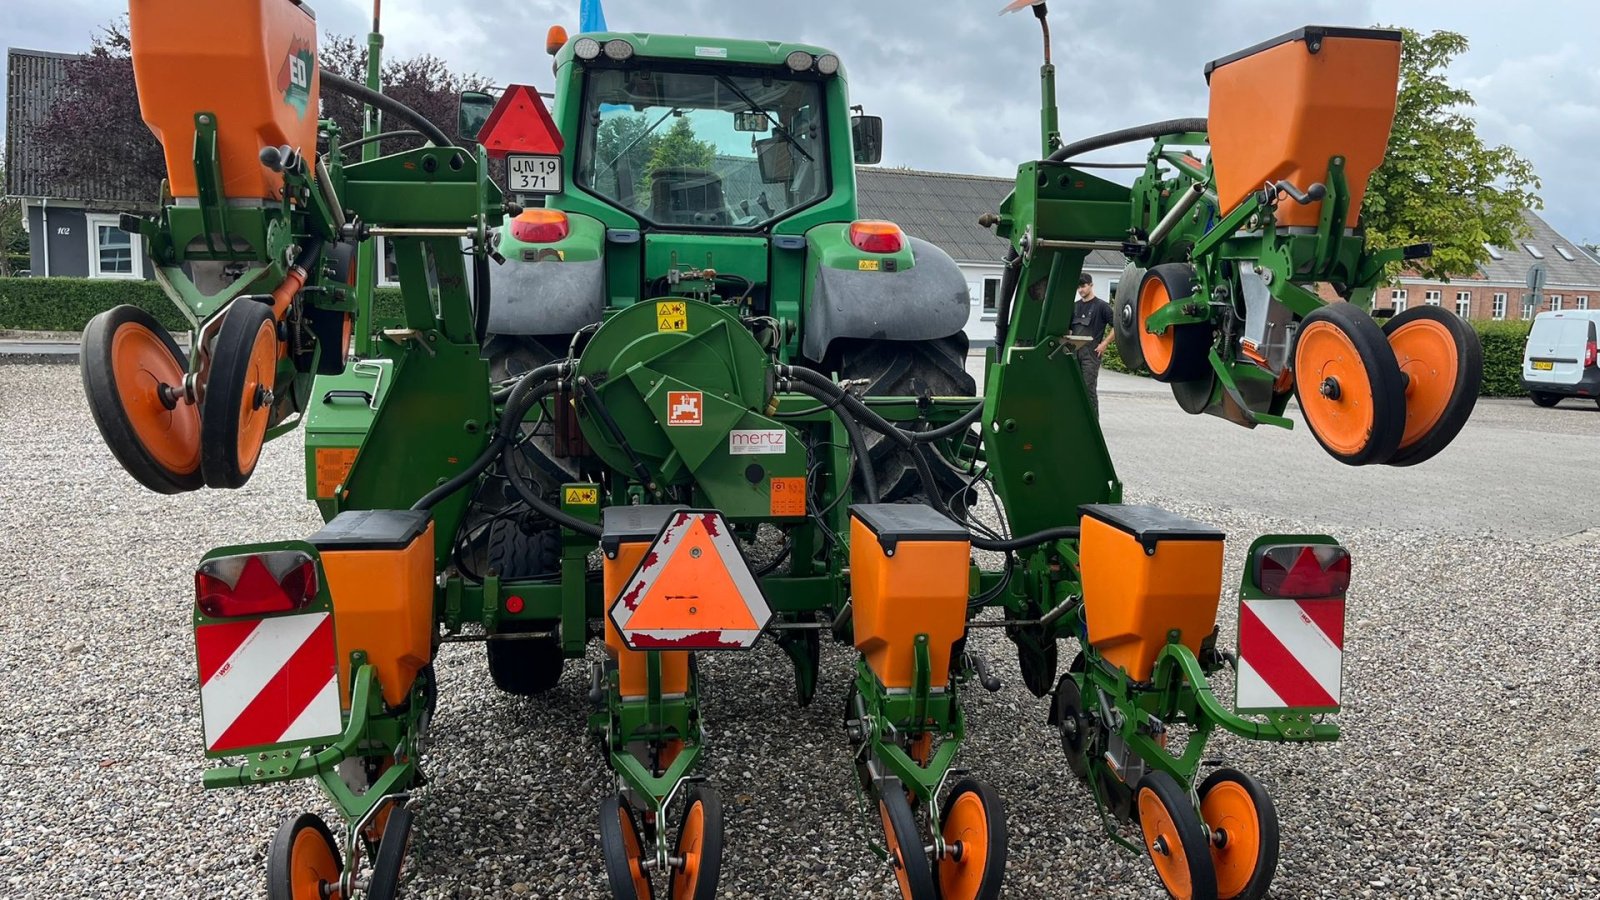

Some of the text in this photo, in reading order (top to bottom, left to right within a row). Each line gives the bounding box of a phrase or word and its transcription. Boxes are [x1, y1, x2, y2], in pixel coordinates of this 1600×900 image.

[289, 54, 307, 88] ED
[513, 160, 556, 173] JN 19
[521, 175, 546, 188] 371
[57, 226, 71, 235] 102
[732, 432, 784, 445] mertz
